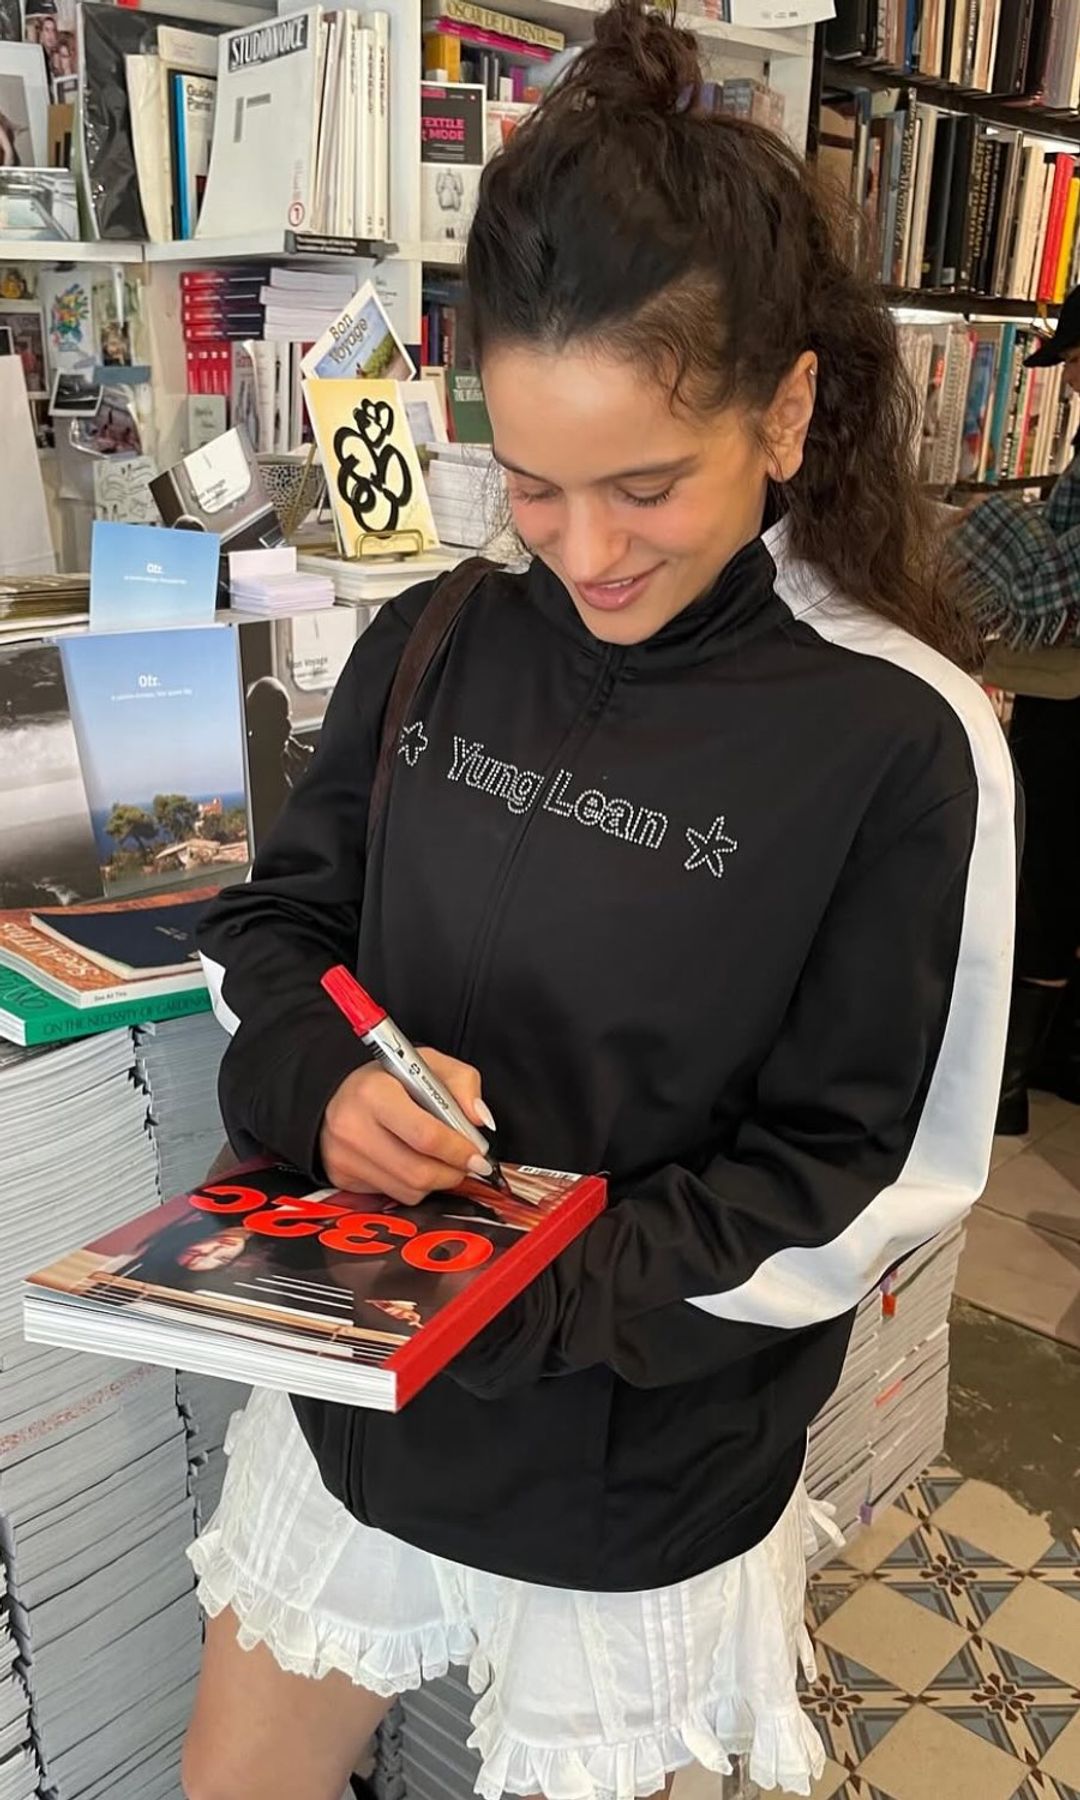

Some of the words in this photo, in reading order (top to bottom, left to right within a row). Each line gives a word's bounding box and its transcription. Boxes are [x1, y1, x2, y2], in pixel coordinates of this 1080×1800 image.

[421, 116, 464, 129] EXTILE
[429, 128, 465, 141] MODE
[447, 735, 545, 814] Yung
[542, 768, 668, 849] Lean
